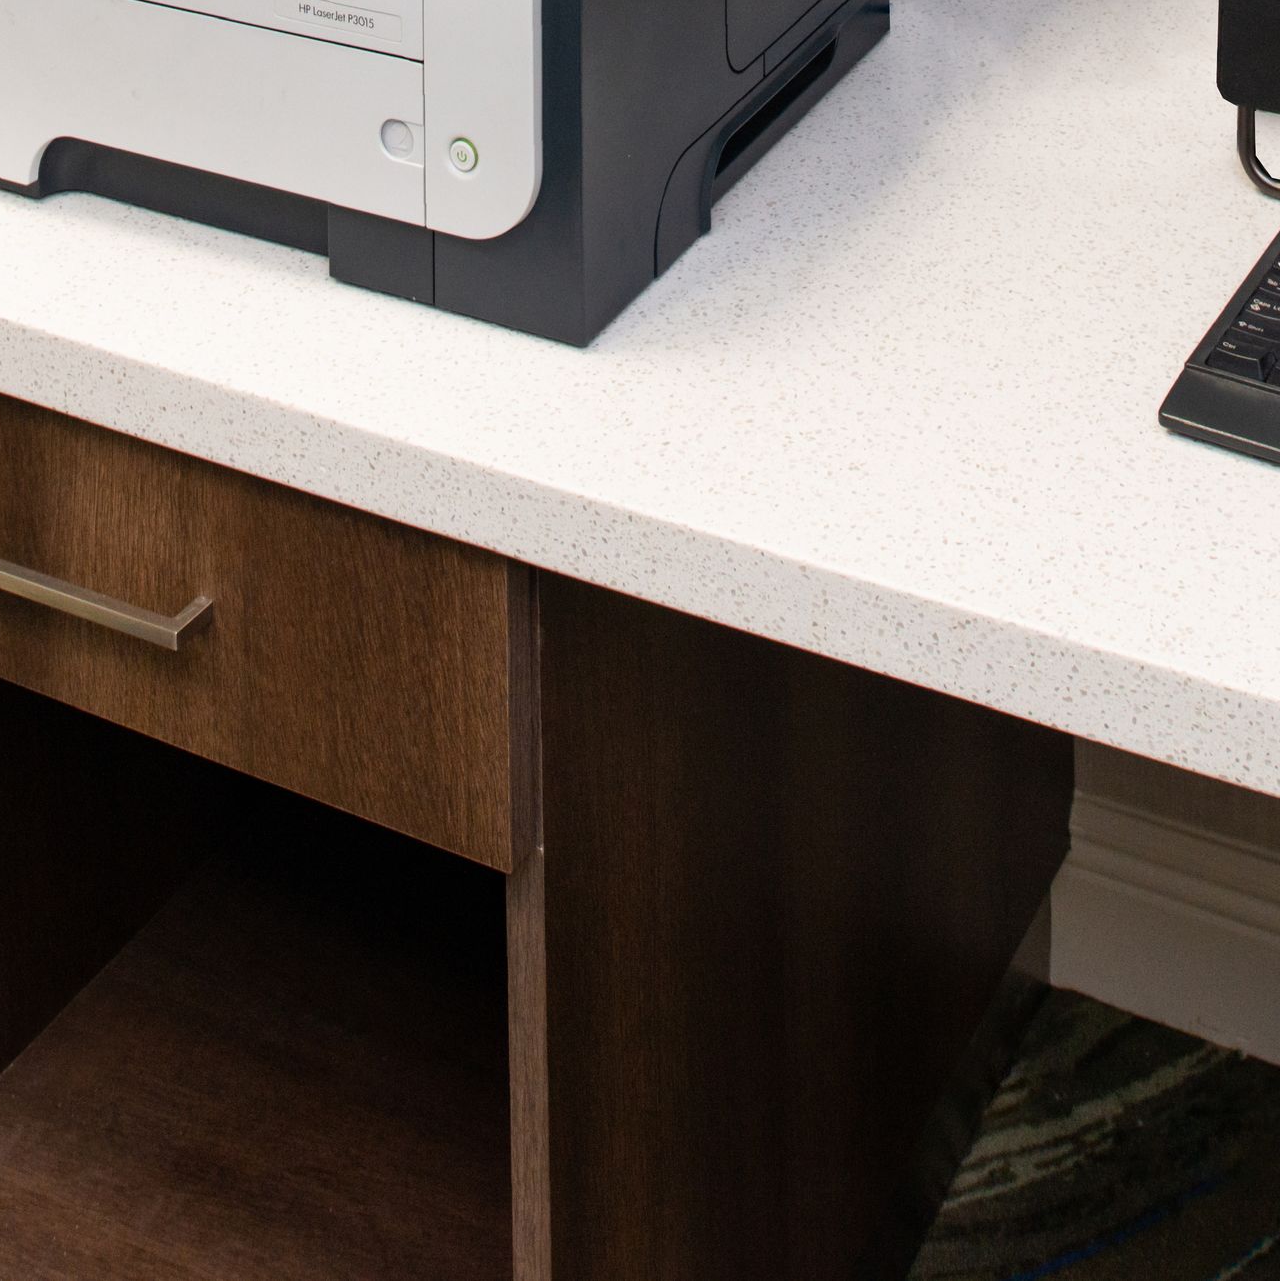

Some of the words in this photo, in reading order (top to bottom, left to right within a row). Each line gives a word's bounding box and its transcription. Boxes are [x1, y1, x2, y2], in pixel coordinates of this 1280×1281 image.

[298, 3, 311, 14] HP
[313, 6, 346, 22] LaserJet
[347, 14, 375, 29] P3015
